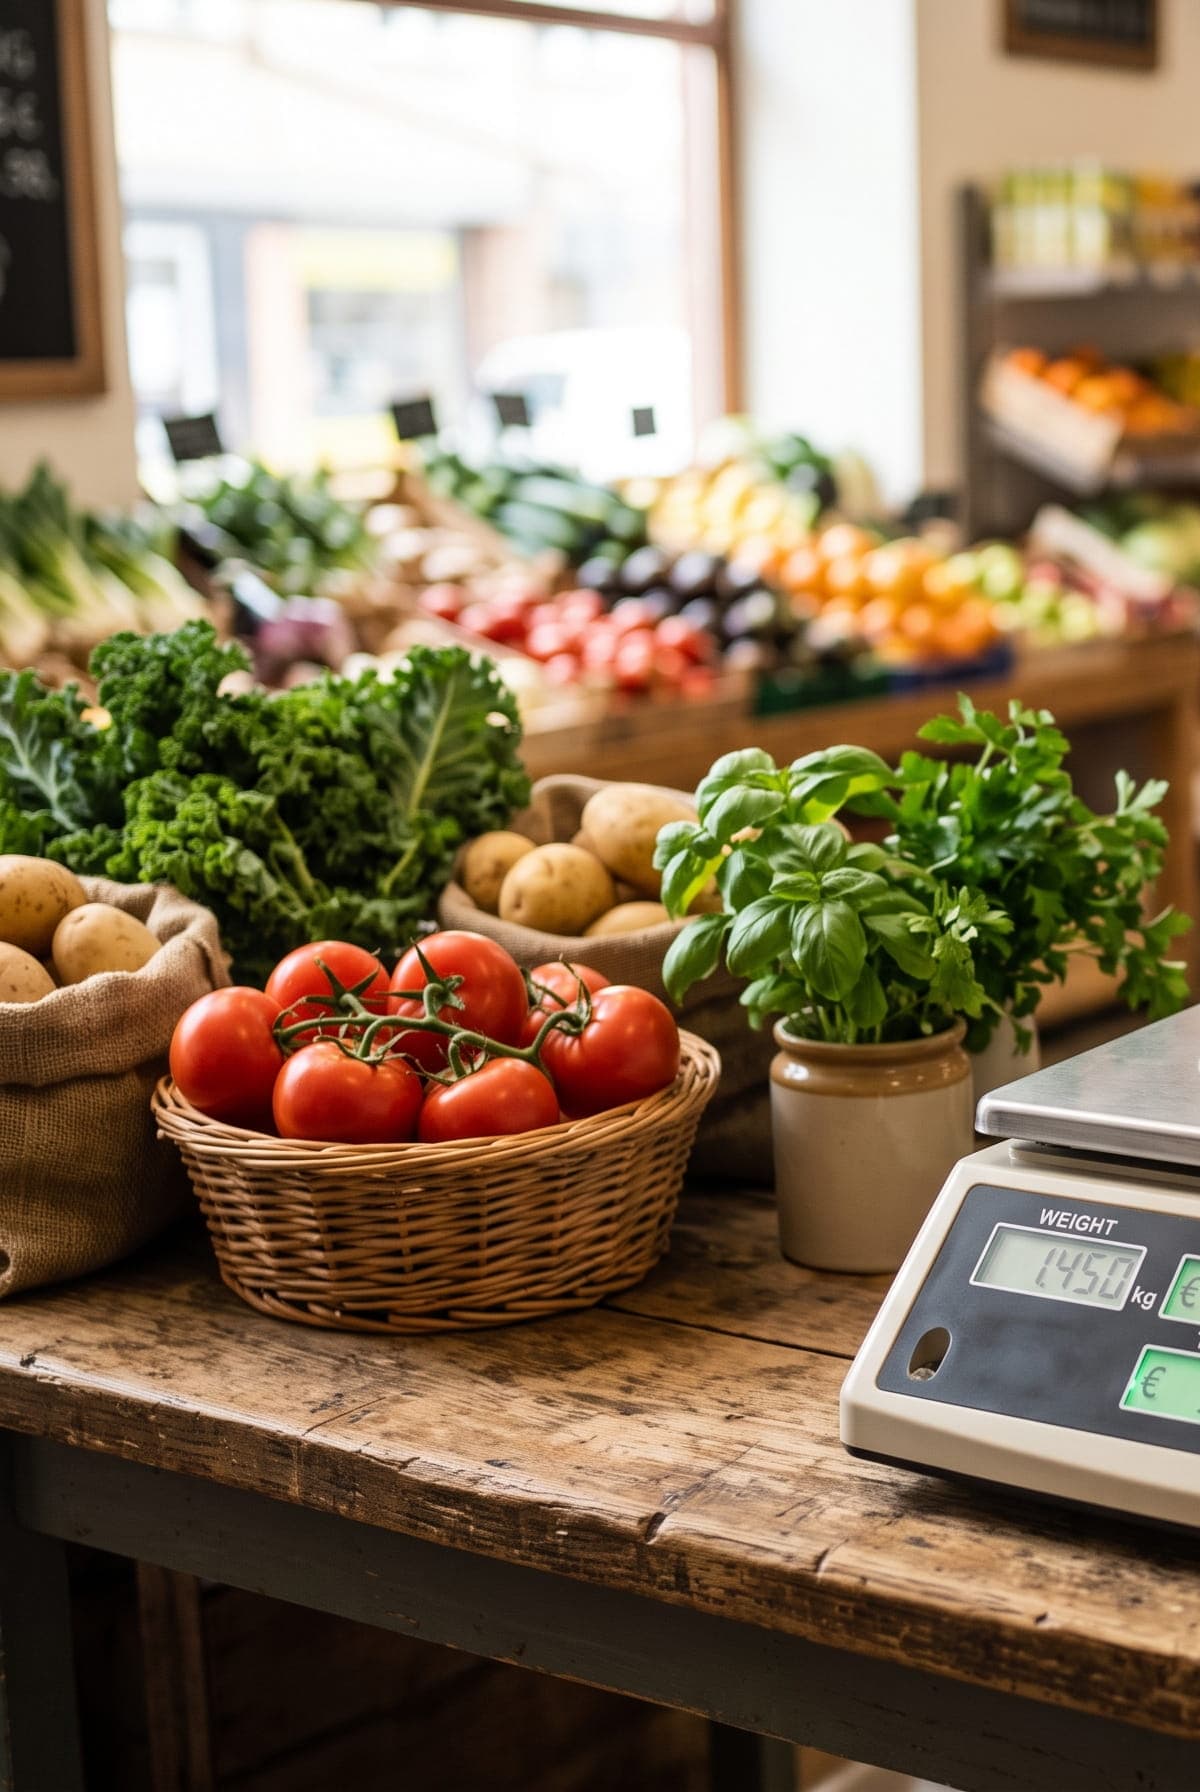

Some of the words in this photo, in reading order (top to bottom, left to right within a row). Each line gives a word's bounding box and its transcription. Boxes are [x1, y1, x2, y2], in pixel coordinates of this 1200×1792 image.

[1040, 1208, 1118, 1235] WEIGHT
[1035, 1247, 1135, 1299] 1.450
[1131, 1285, 1157, 1310] kg
[1141, 1366, 1166, 1399] €
